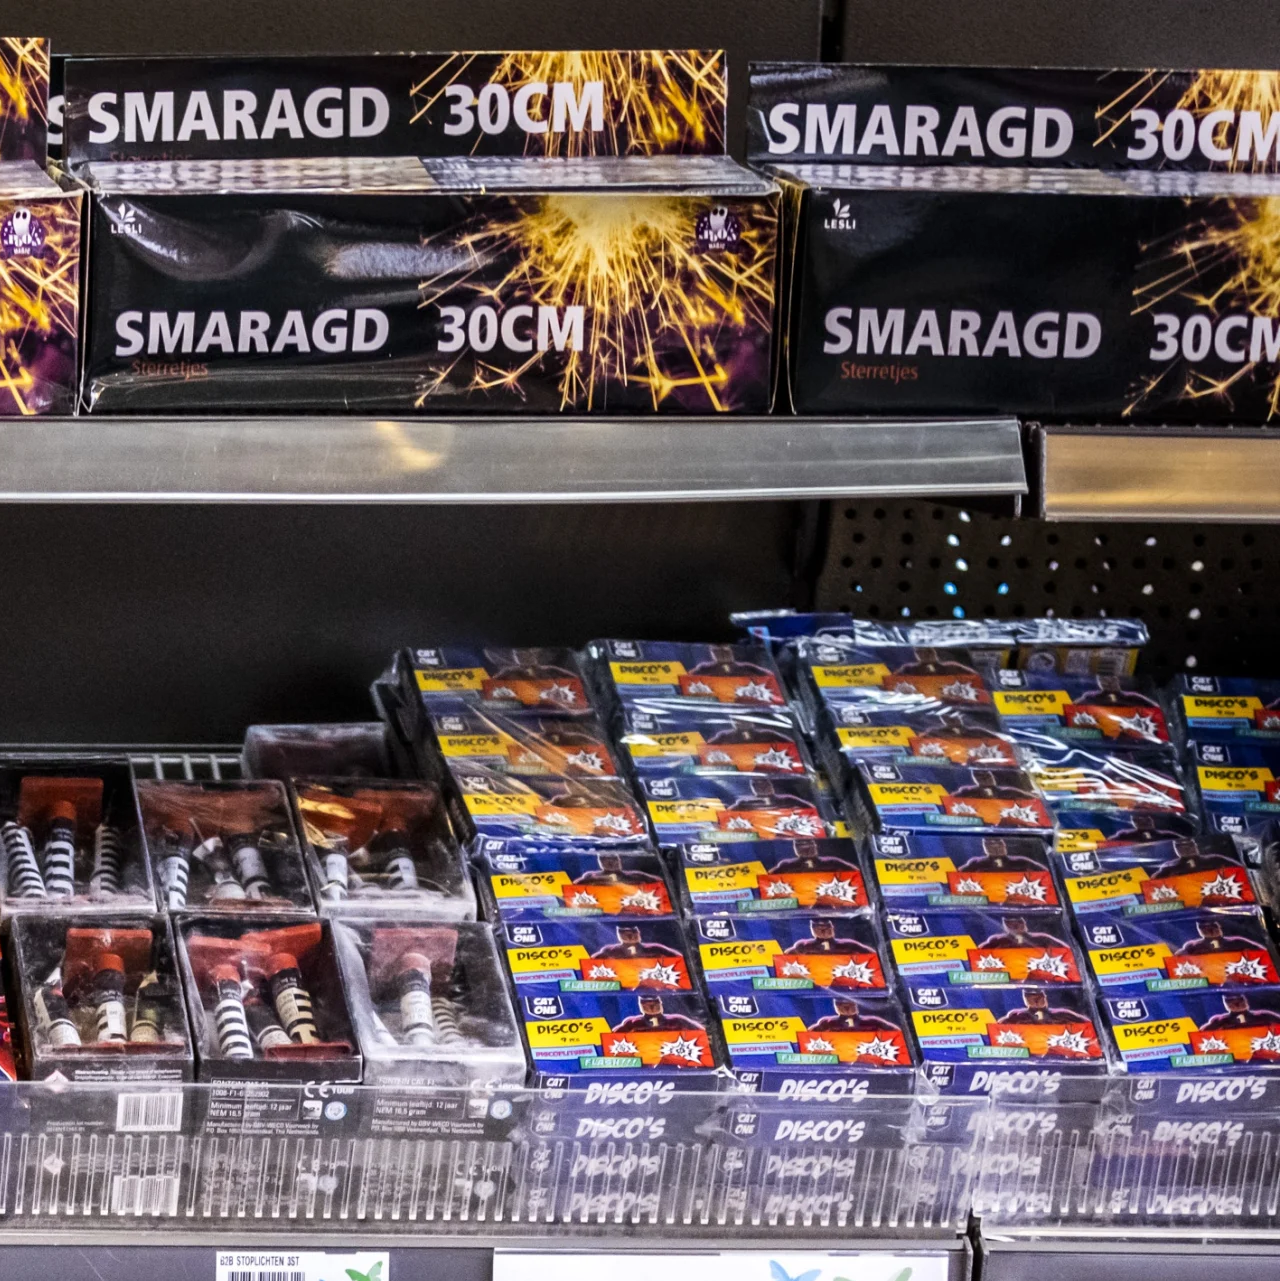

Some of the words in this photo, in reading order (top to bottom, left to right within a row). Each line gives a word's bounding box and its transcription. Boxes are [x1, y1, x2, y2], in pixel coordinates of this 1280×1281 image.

[88, 86, 389, 144] SMARAGD
[444, 82, 604, 135] 30CM
[768, 103, 1073, 157] SMARAGD
[824, 218, 856, 229] LESLI
[115, 309, 389, 357] SMARAGD
[437, 307, 584, 353] 30CM
[823, 307, 1101, 359] SMARAGD
[841, 361, 918, 382] Sterretjes
[537, 1024, 594, 1035] DISCO'S
[922, 1013, 980, 1024] DISCO'S
[1123, 1023, 1181, 1038] DISCO'S
[778, 1078, 869, 1102] DISCO'S
[969, 1070, 1062, 1094] DISCO'S
[1176, 1077, 1267, 1103] DISCO'S
[237, 1256, 284, 1267] STOPLICHTEN
